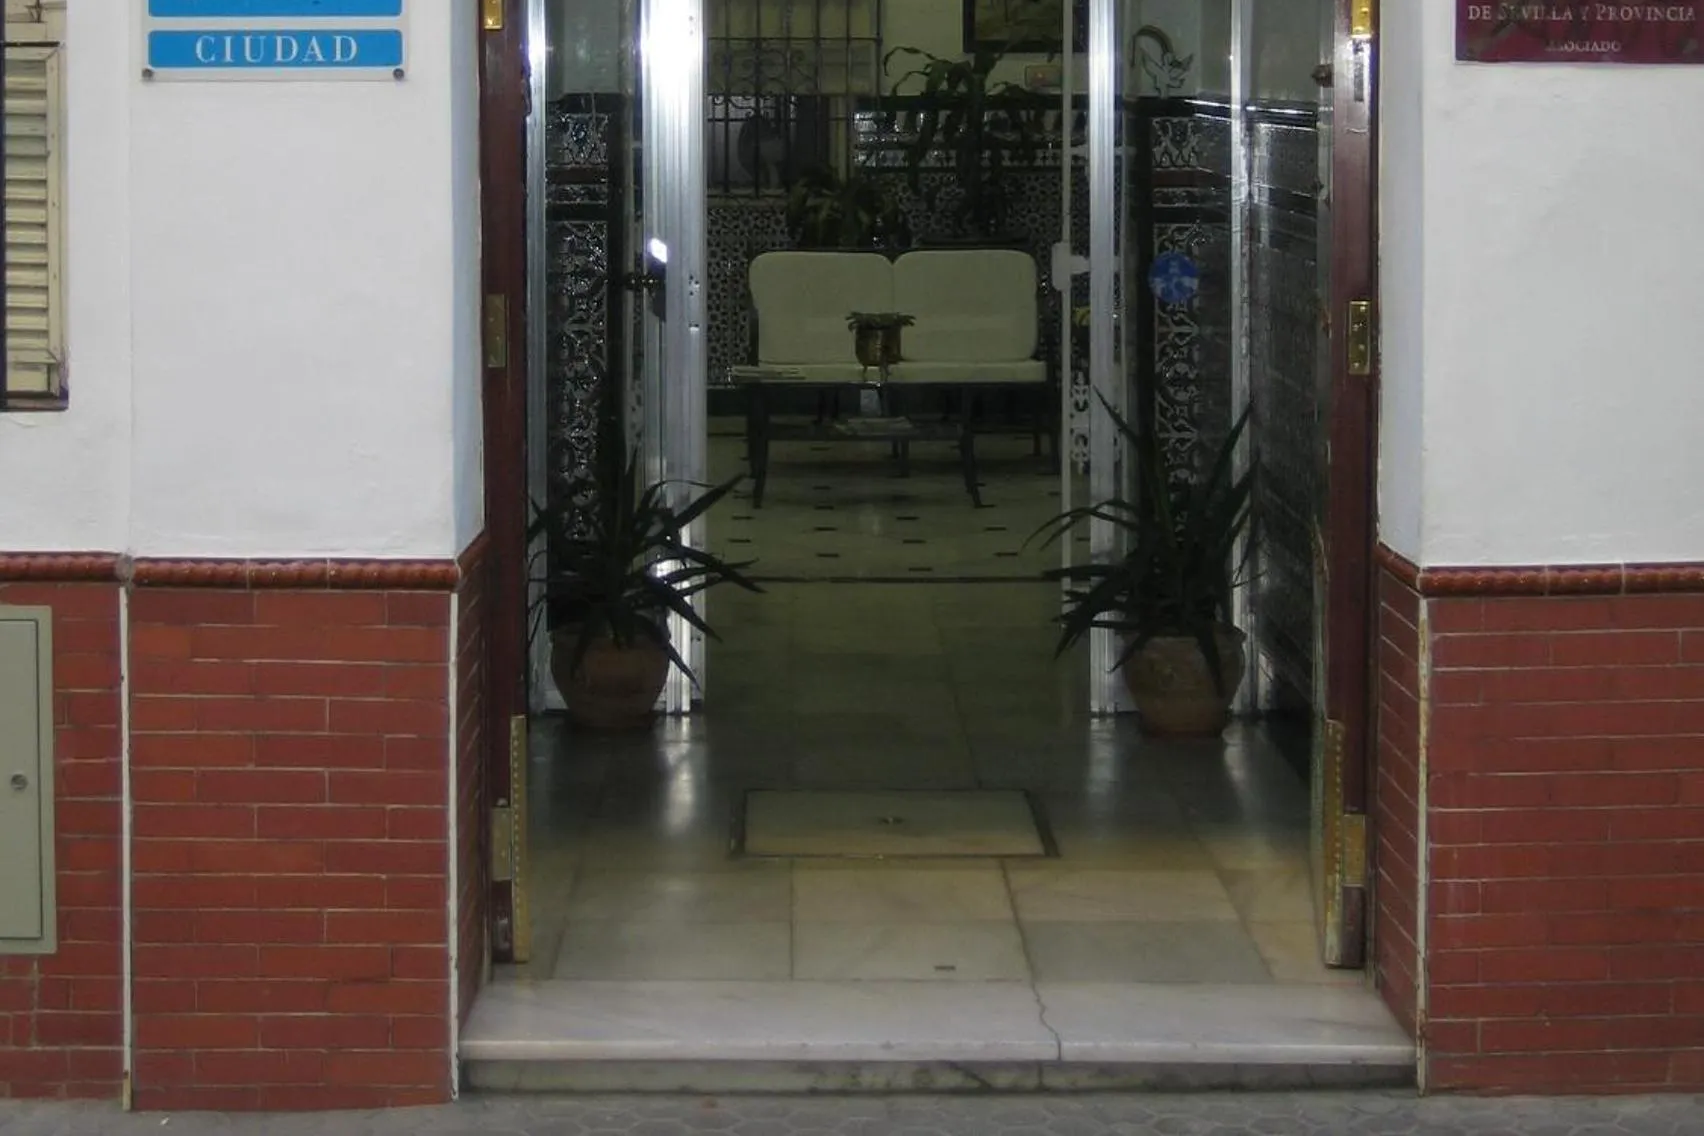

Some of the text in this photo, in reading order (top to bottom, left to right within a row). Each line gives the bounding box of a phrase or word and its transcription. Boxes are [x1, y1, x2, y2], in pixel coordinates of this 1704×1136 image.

[1468, 5, 1491, 20] DE
[1596, 4, 1696, 21] PROVINCIA
[196, 34, 358, 64] CIUDAD
